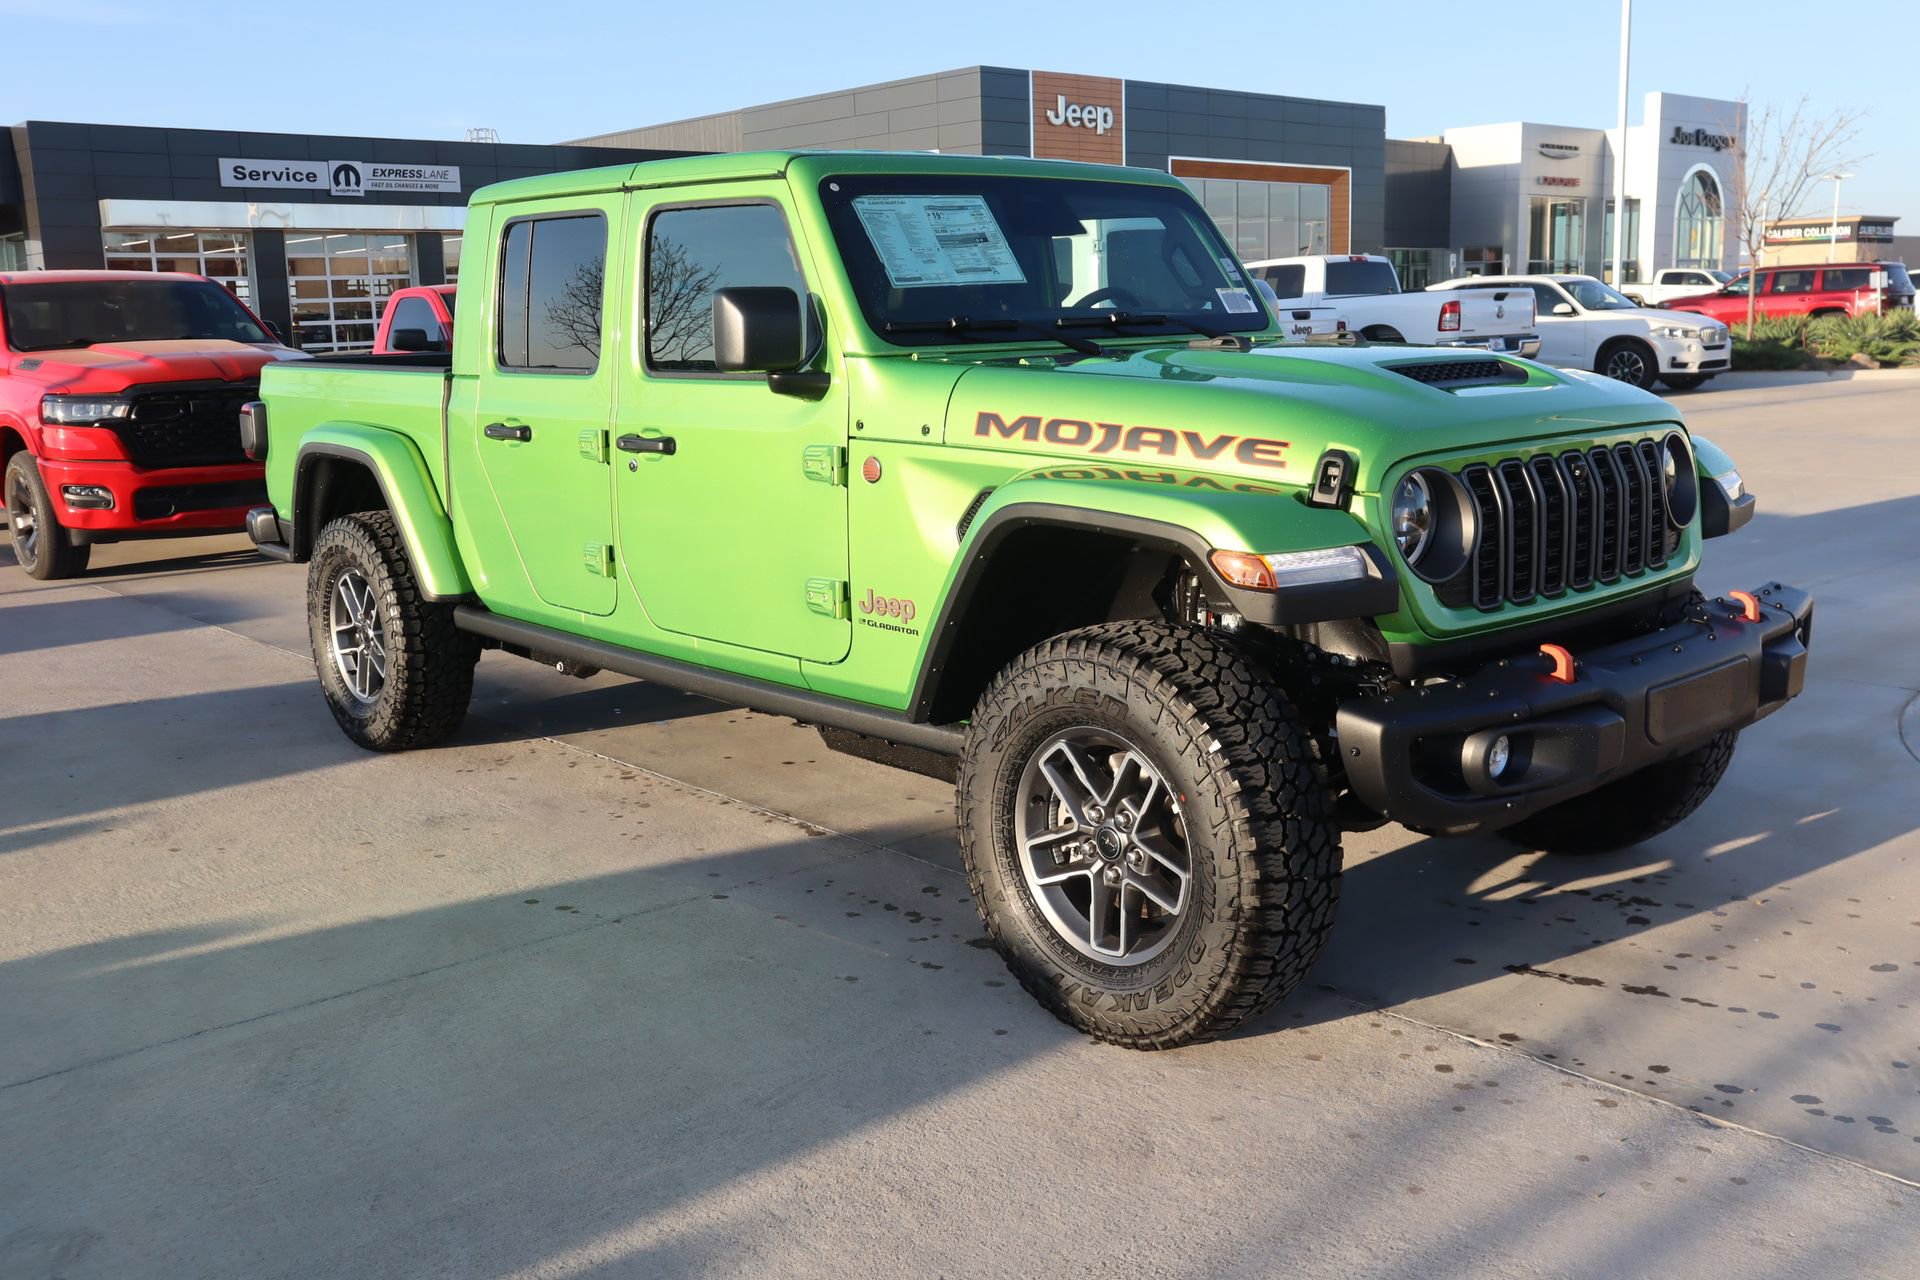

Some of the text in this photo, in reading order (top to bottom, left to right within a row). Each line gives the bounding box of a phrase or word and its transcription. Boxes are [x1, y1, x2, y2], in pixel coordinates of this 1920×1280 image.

[1046, 94, 1113, 135] Jeep
[232, 165, 318, 183] Service
[1766, 229, 1803, 239] CALIBER
[1803, 226, 1851, 238] COLLISON
[1291, 323, 1313, 336] Jeep
[974, 411, 1291, 469] MOJAVE
[858, 588, 916, 625] Jeep
[867, 619, 919, 636] GLADIATOR
[990, 685, 1130, 752] FALKEN
